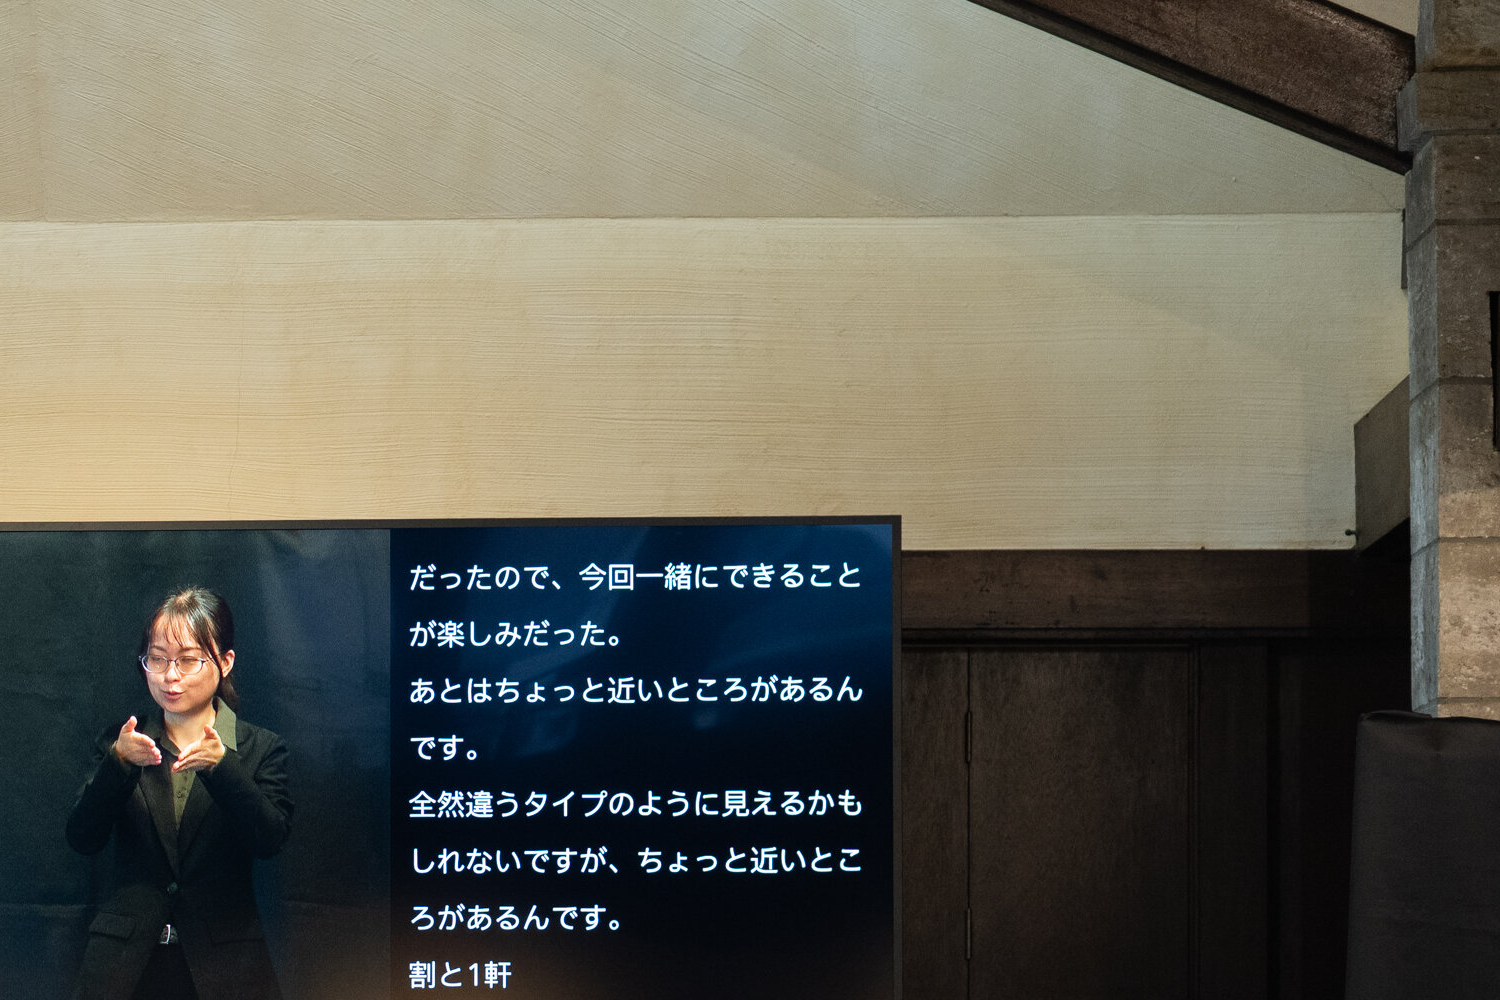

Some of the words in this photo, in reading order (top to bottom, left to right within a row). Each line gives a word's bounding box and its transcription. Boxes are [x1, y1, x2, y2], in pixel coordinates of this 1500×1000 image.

[410, 562, 861, 592] だったので、今回一緒にできること
[409, 619, 621, 649] が楽しみだった。
[410, 674, 863, 705] あとはちょっと近いところがあるん
[410, 734, 478, 761] です。
[408, 789, 862, 819] 全然違うタイプのように見えるかも
[412, 845, 861, 875] しれないですが、ちょっと近いとこ
[410, 903, 621, 931] ろがあるんです。
[408, 960, 512, 990] 割と1軒
